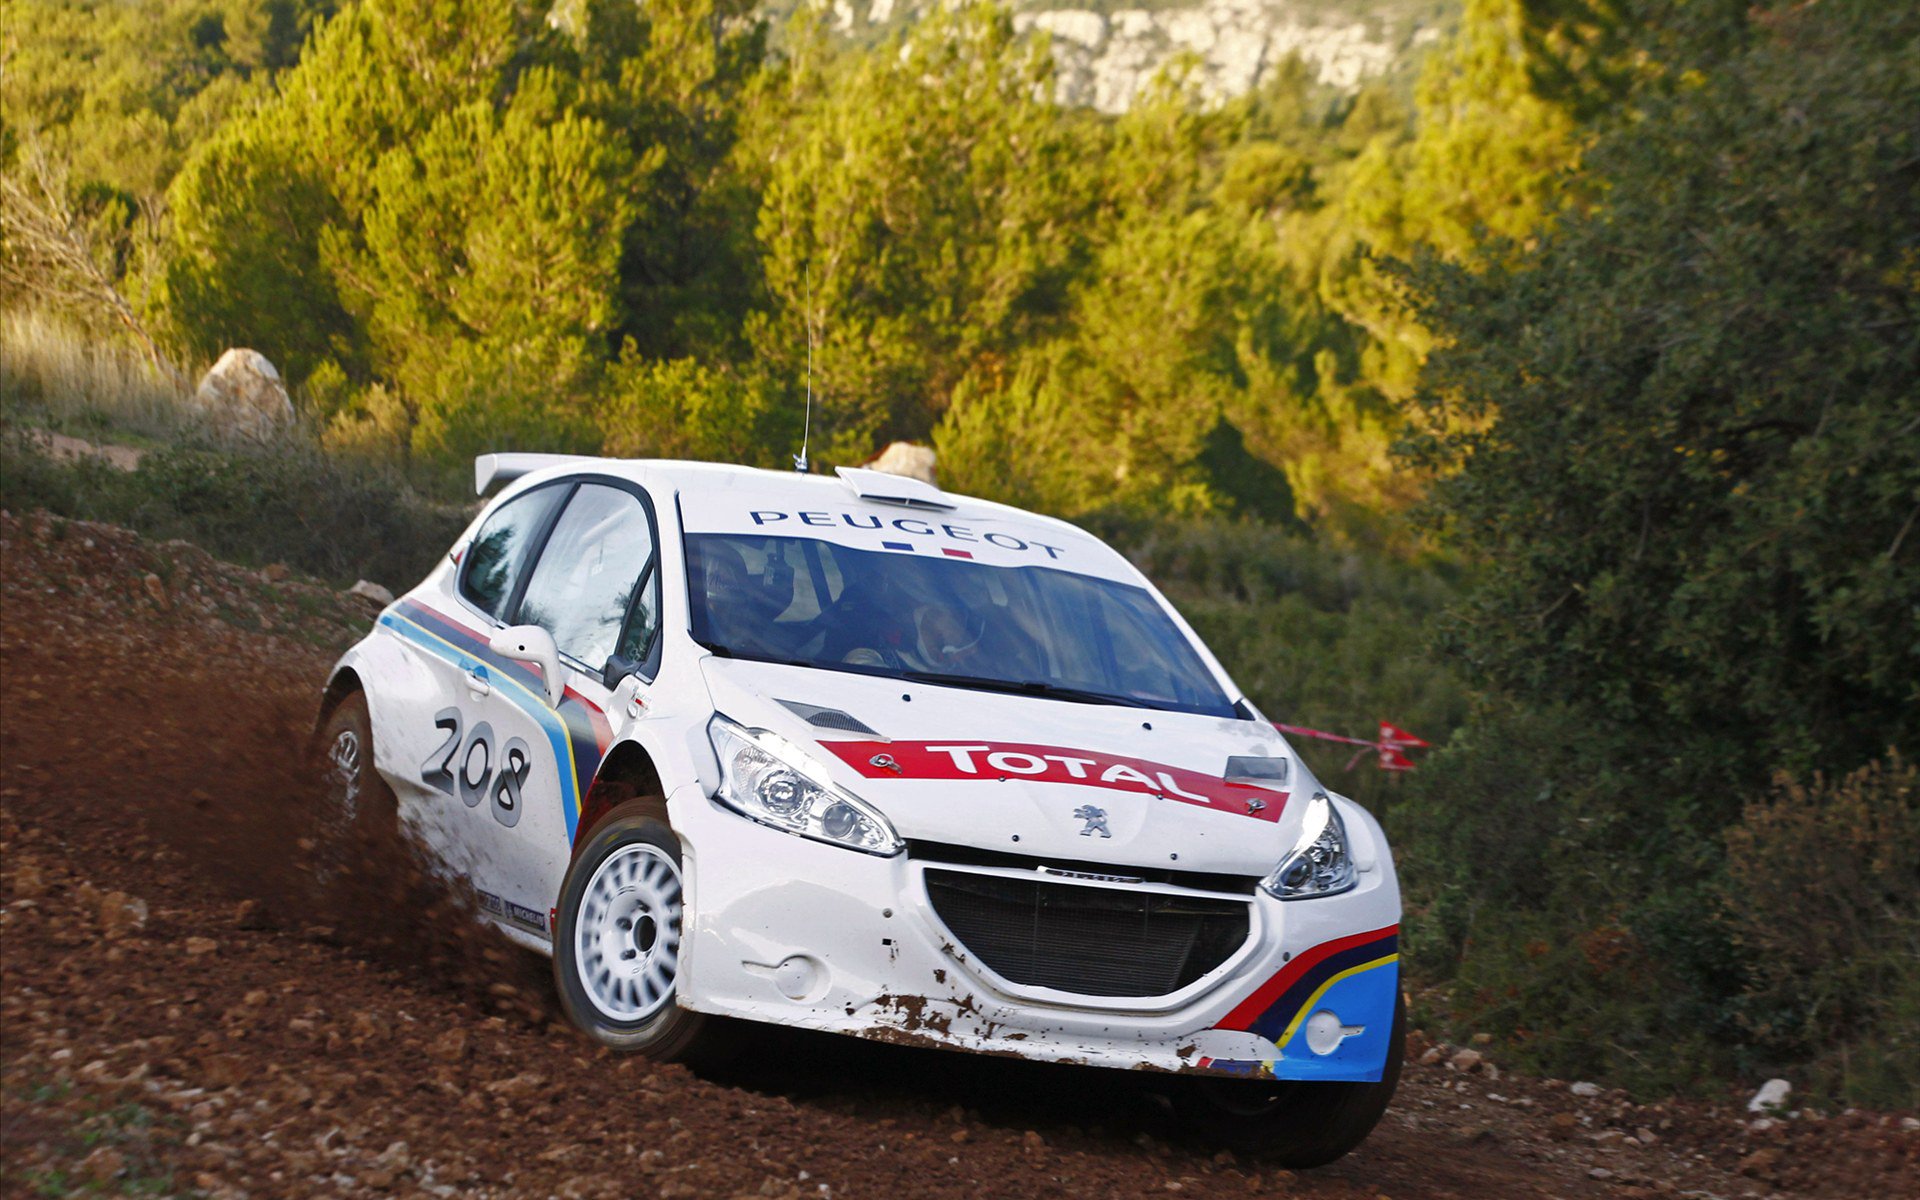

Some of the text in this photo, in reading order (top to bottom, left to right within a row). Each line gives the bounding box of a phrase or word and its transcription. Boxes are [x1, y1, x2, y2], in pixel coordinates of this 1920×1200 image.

[749, 511, 1065, 560] PEUGEOT
[421, 706, 531, 828] 208
[926, 745, 1210, 803] TOTAL
